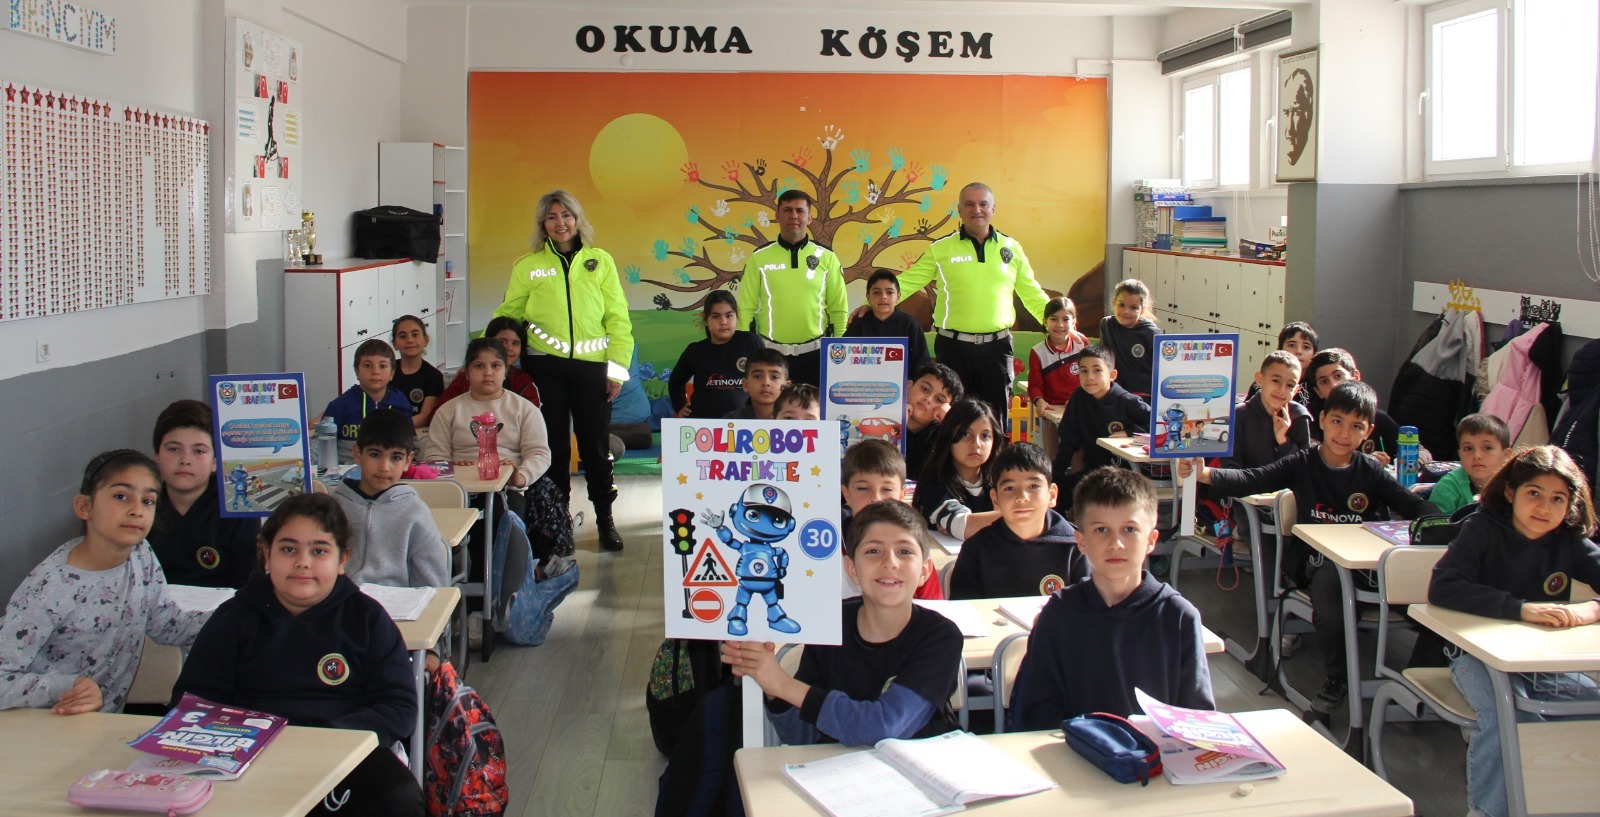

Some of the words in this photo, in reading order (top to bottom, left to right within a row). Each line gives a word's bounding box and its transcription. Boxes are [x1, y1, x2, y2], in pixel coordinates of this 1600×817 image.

[575, 25, 753, 54] OKUMA
[820, 26, 993, 63] KÖŞEM
[679, 422, 818, 454] POLİROBOT
[696, 455, 800, 483] TRAFİKTE
[806, 529, 833, 548] 30
[180, 711, 206, 723] 3
